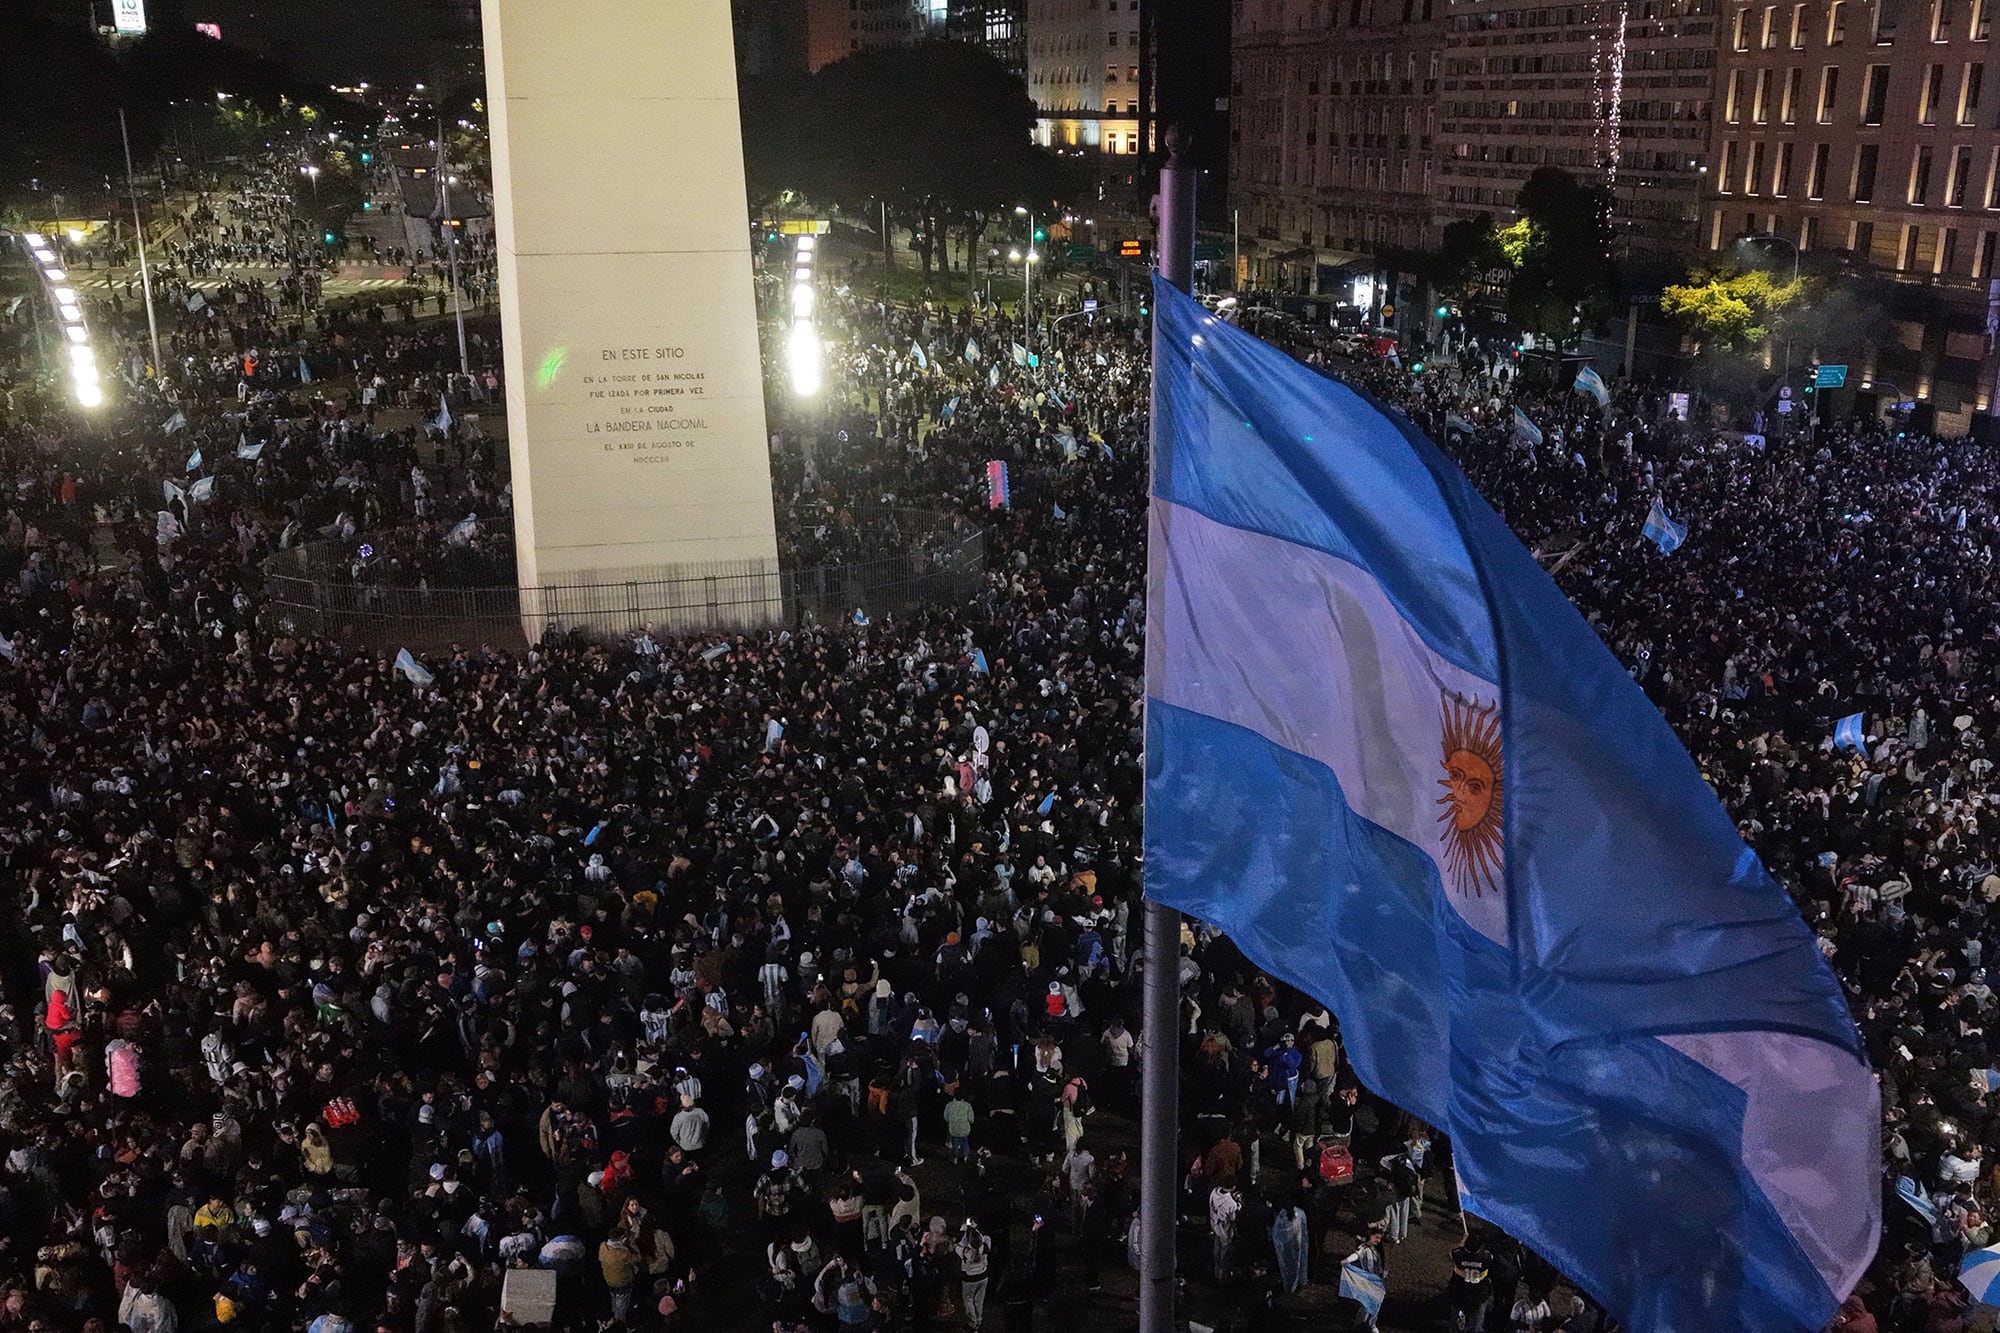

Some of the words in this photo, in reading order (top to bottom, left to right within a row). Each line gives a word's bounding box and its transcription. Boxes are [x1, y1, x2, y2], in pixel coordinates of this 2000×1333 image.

[602, 349, 617, 361] EN
[622, 348, 650, 360] ESTE
[656, 347, 685, 359] SITIO
[674, 372, 705, 380] NICOLAS
[653, 388, 685, 396] PRIMERA
[647, 405, 674, 413] CIUDAD
[586, 423, 601, 433] LA
[606, 420, 652, 432] BANDERA
[657, 418, 708, 430] NACIONAL
[604, 443, 614, 451] EL
[651, 441, 682, 449] AGOSTO
[686, 440, 695, 448] DE
